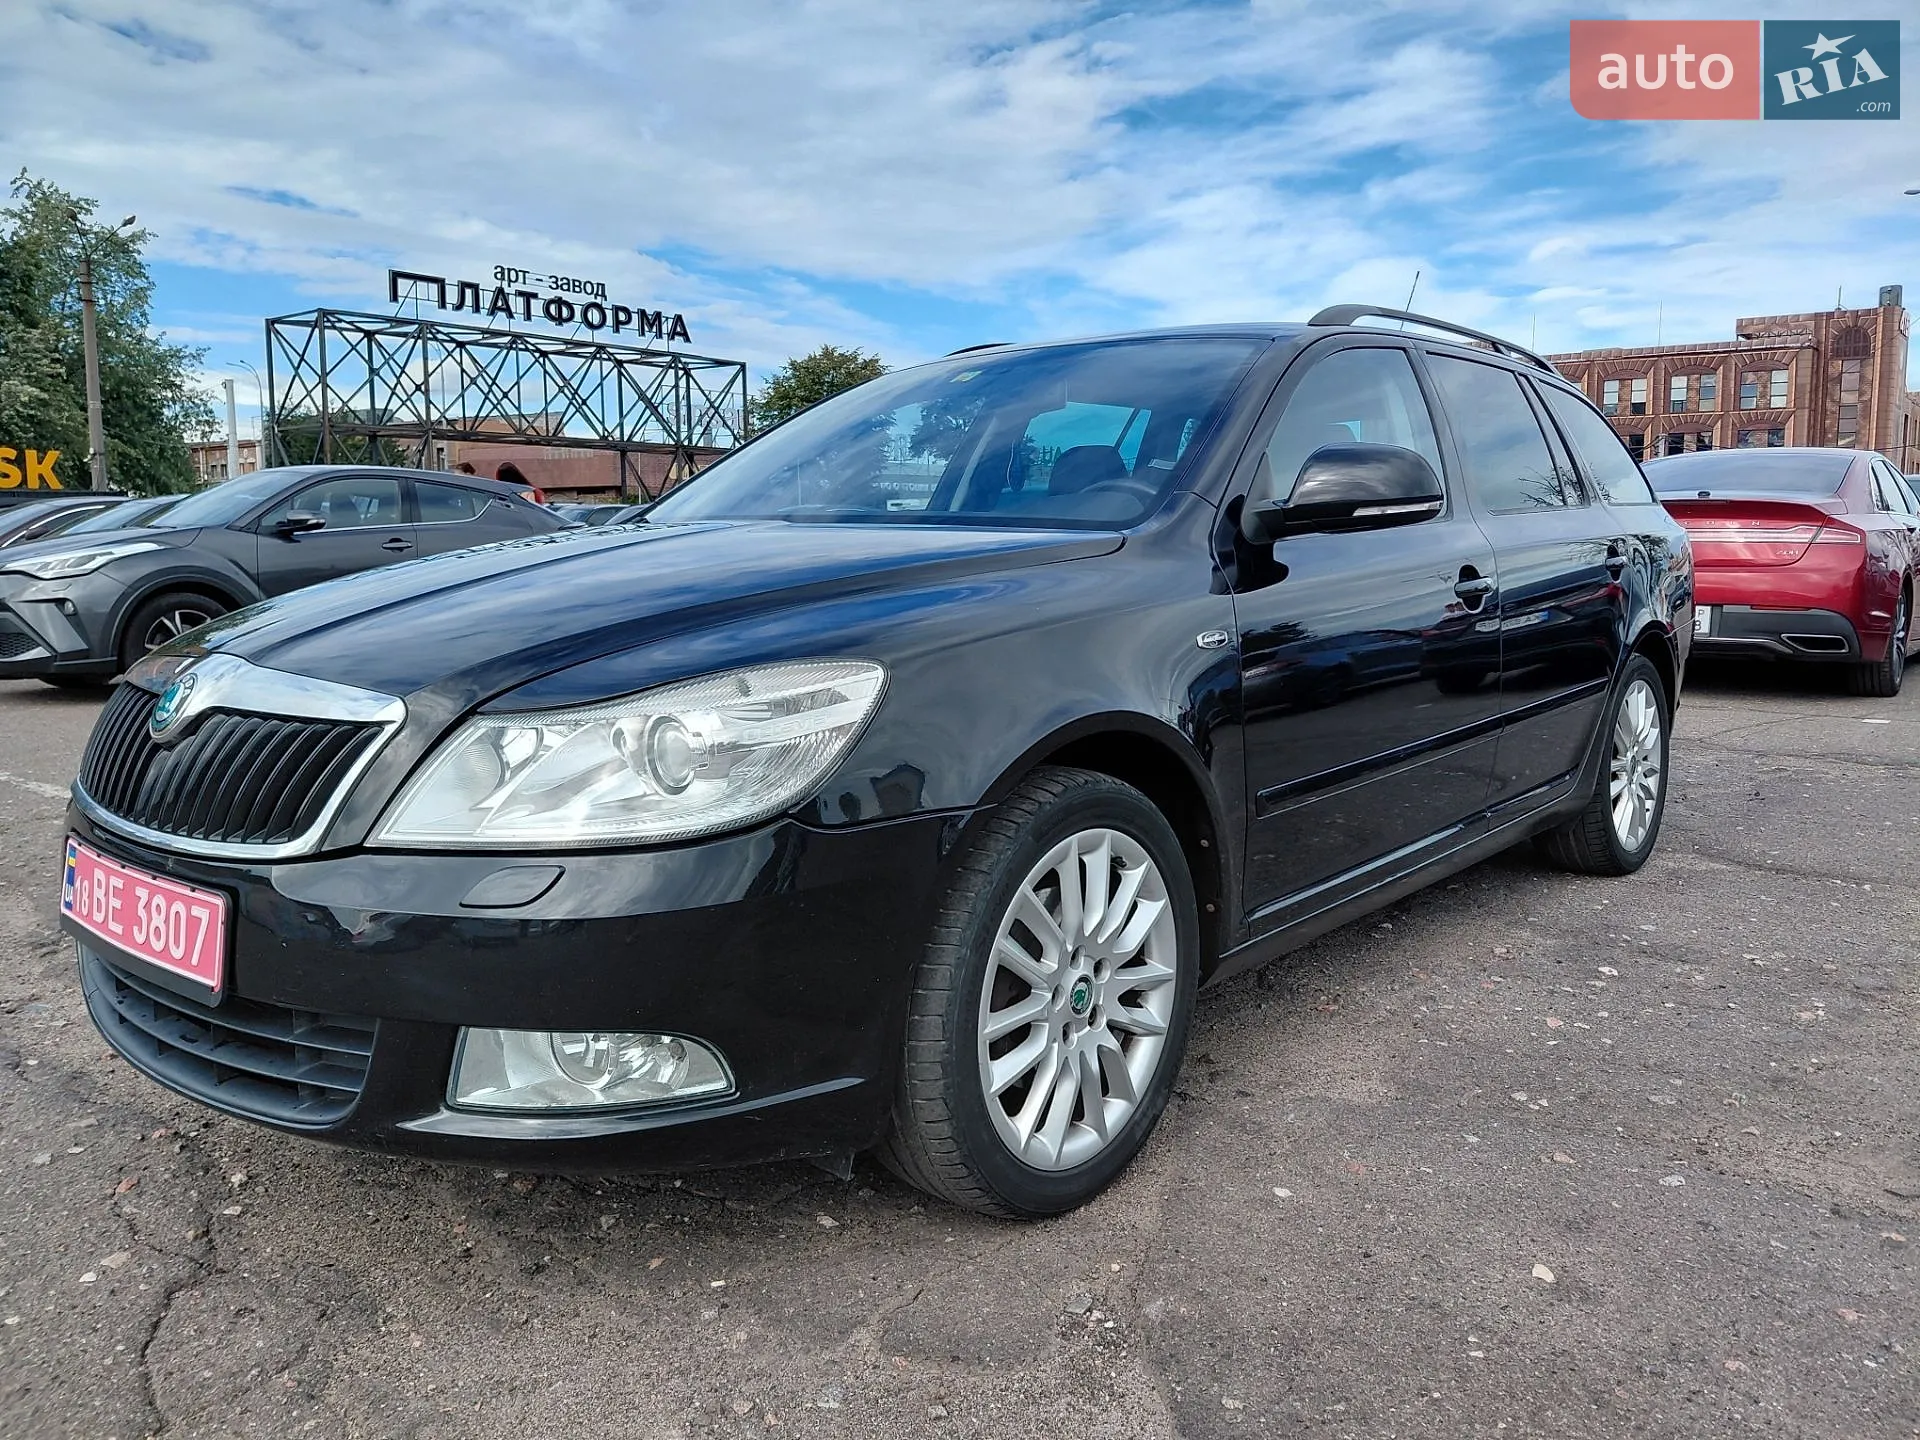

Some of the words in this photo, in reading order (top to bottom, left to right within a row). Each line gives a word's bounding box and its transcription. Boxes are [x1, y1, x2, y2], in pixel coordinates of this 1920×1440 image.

[388, 268, 692, 343] ПЛАТФОРМА
[493, 264, 530, 287] арт
[548, 275, 608, 301] завод
[93, 867, 124, 935] BE
[132, 886, 210, 967] 3807
